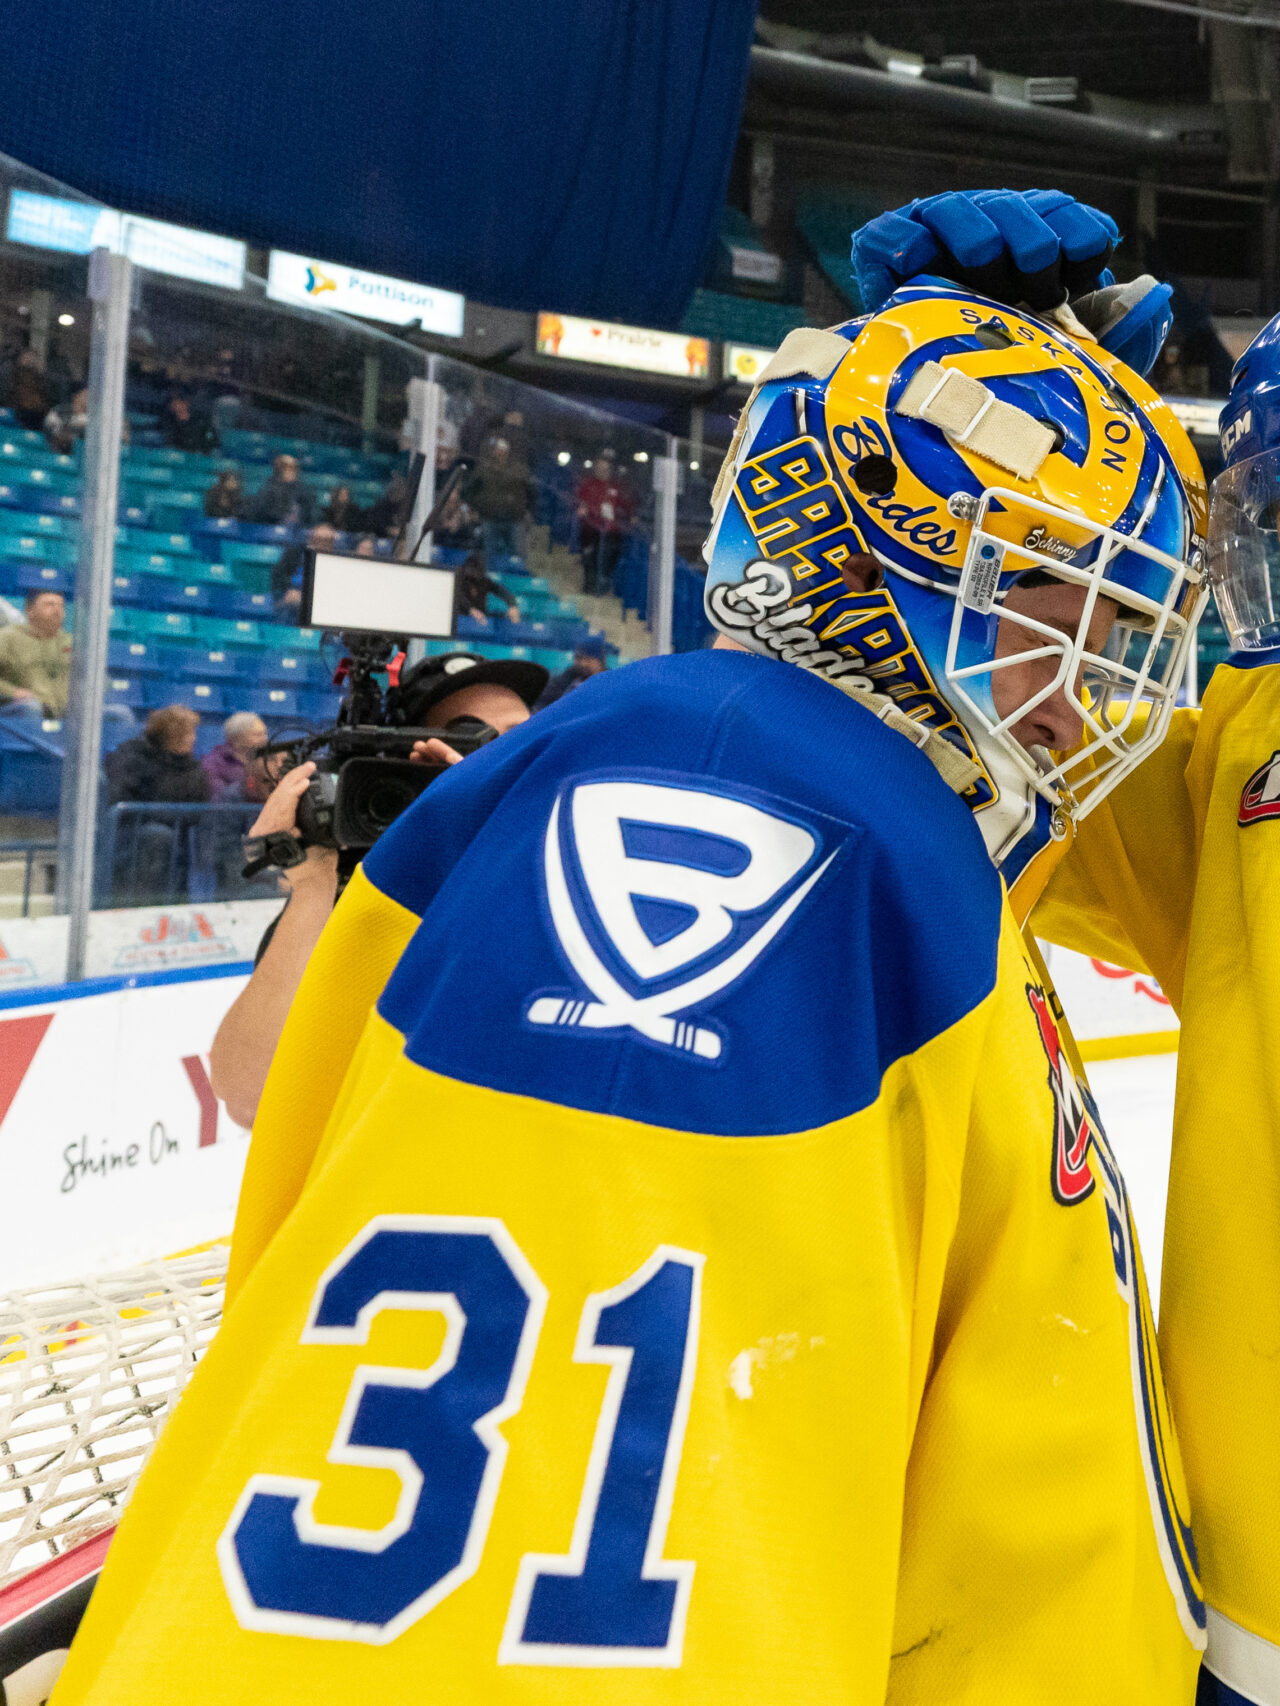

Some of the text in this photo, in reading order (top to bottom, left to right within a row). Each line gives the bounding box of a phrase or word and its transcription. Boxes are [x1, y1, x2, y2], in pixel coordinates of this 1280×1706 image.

[349, 275, 434, 308] Pattison
[1024, 527, 1077, 562] Schinny
[60, 1121, 181, 1195] Shine On
[217, 1214, 706, 1668] 31
